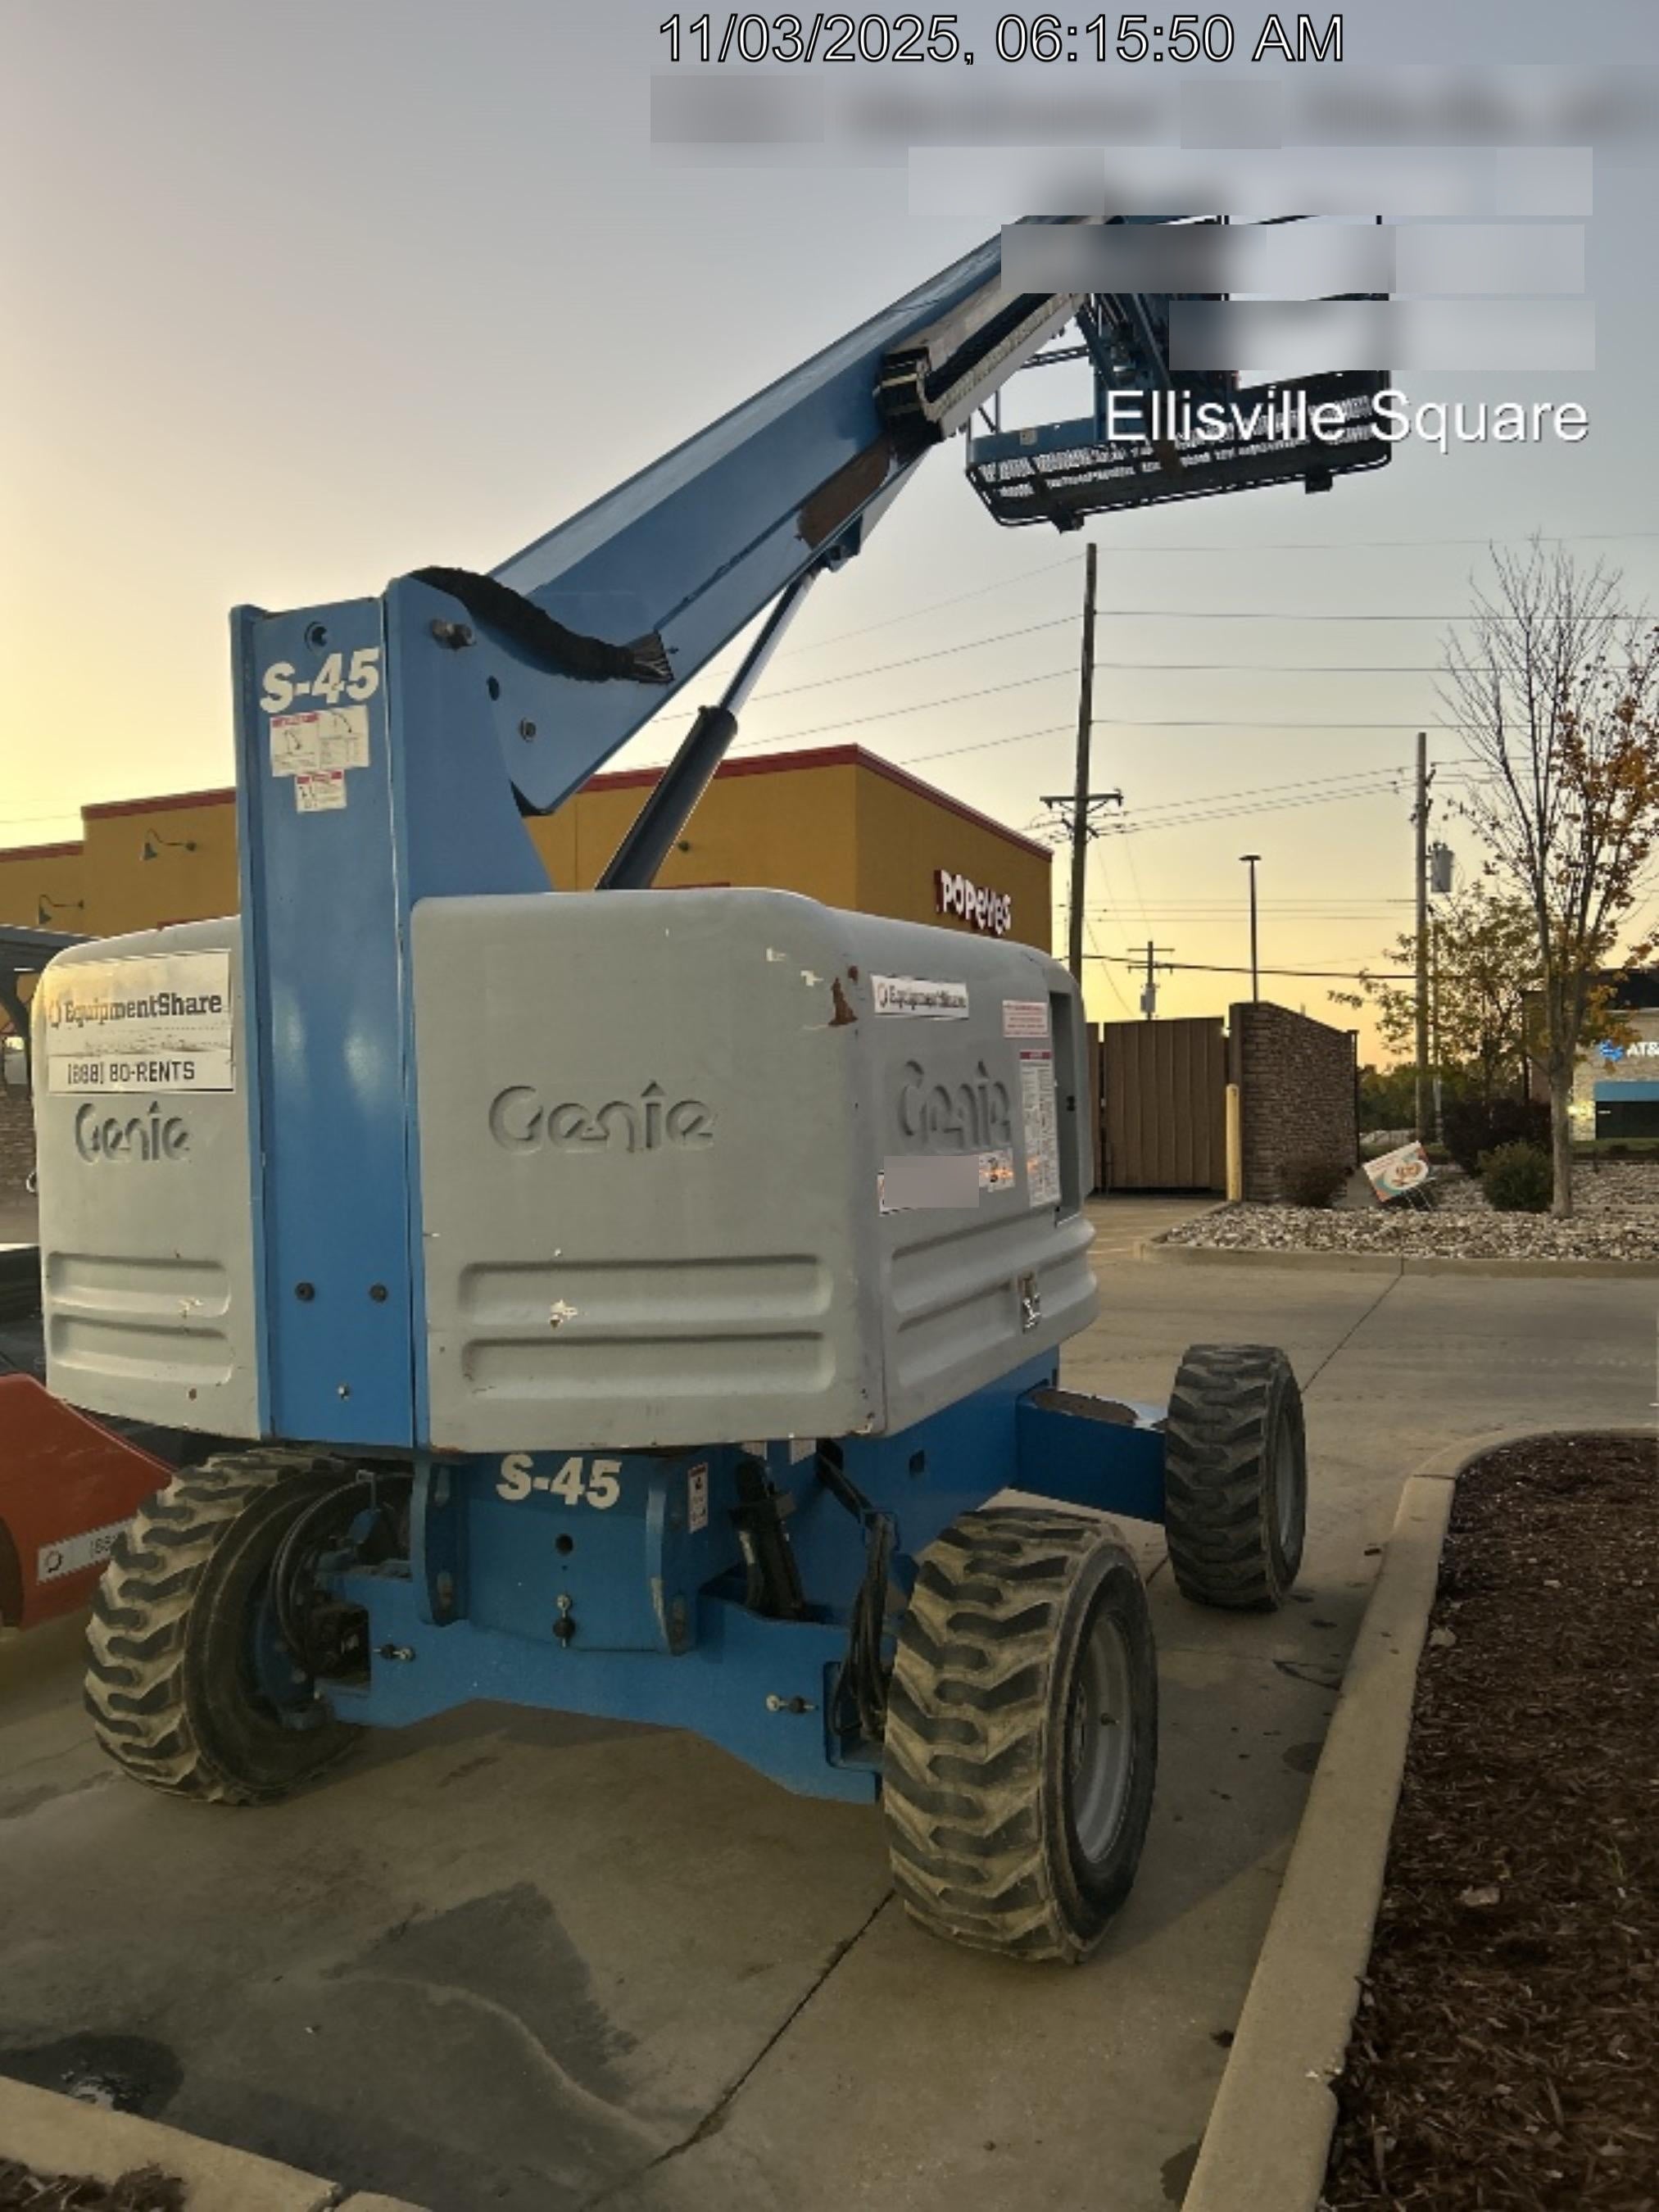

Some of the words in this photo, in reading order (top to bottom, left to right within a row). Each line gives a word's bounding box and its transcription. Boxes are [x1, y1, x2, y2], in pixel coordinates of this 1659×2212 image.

[260, 647, 379, 713] S-45
[65, 992, 222, 1028] EquipmentShare
[75, 1100, 191, 1163] Genie
[489, 1081, 715, 1155] Genie
[899, 1059, 1013, 1151] Genie
[496, 1453, 623, 1509] S-45
